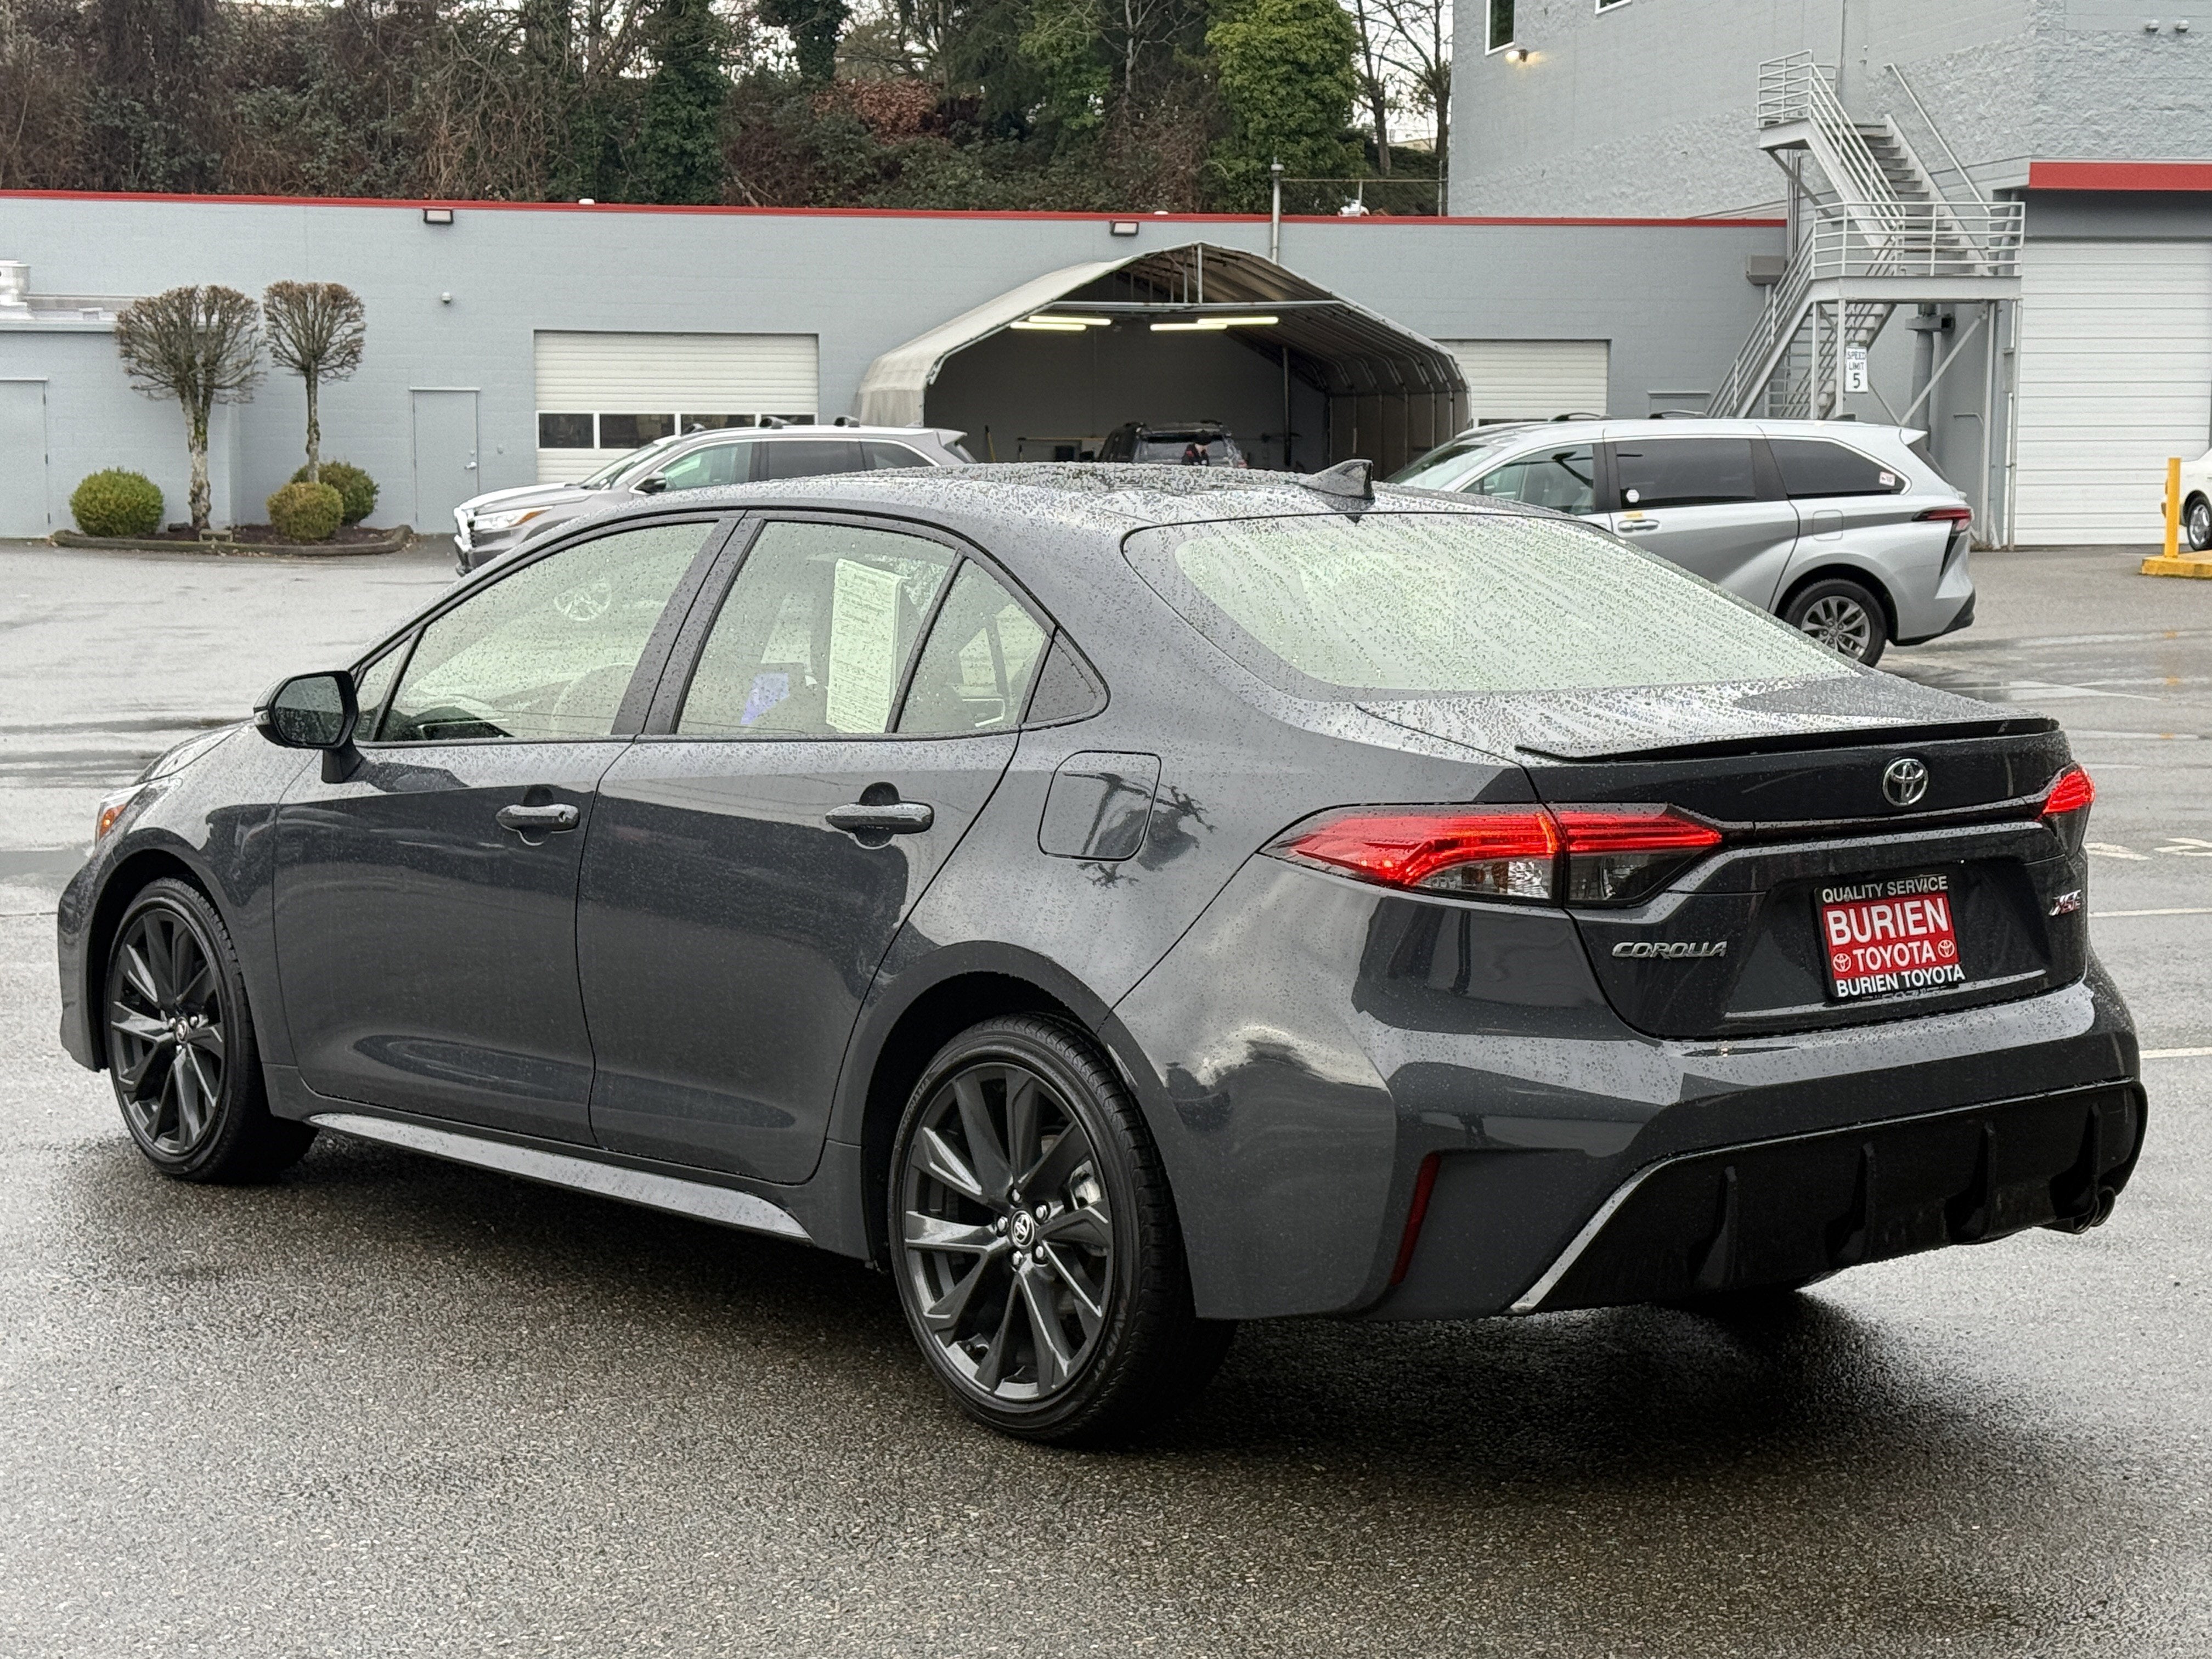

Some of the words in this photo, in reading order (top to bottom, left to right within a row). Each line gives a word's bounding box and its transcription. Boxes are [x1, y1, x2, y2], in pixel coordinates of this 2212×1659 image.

[1847, 351, 1866, 360] SPEED
[1849, 362, 1864, 370] LIMIT
[1853, 373, 1860, 389] 5
[1822, 883, 1883, 903] QUALITY
[1887, 876, 1948, 896] SERVICE
[1827, 898, 1948, 946] BURIEN
[1612, 941, 1728, 960] COROLLA
[1853, 940, 1937, 972] TOYOTA
[1836, 973, 1899, 997] BURIEN
[1901, 964, 1965, 988] TOYOTA
